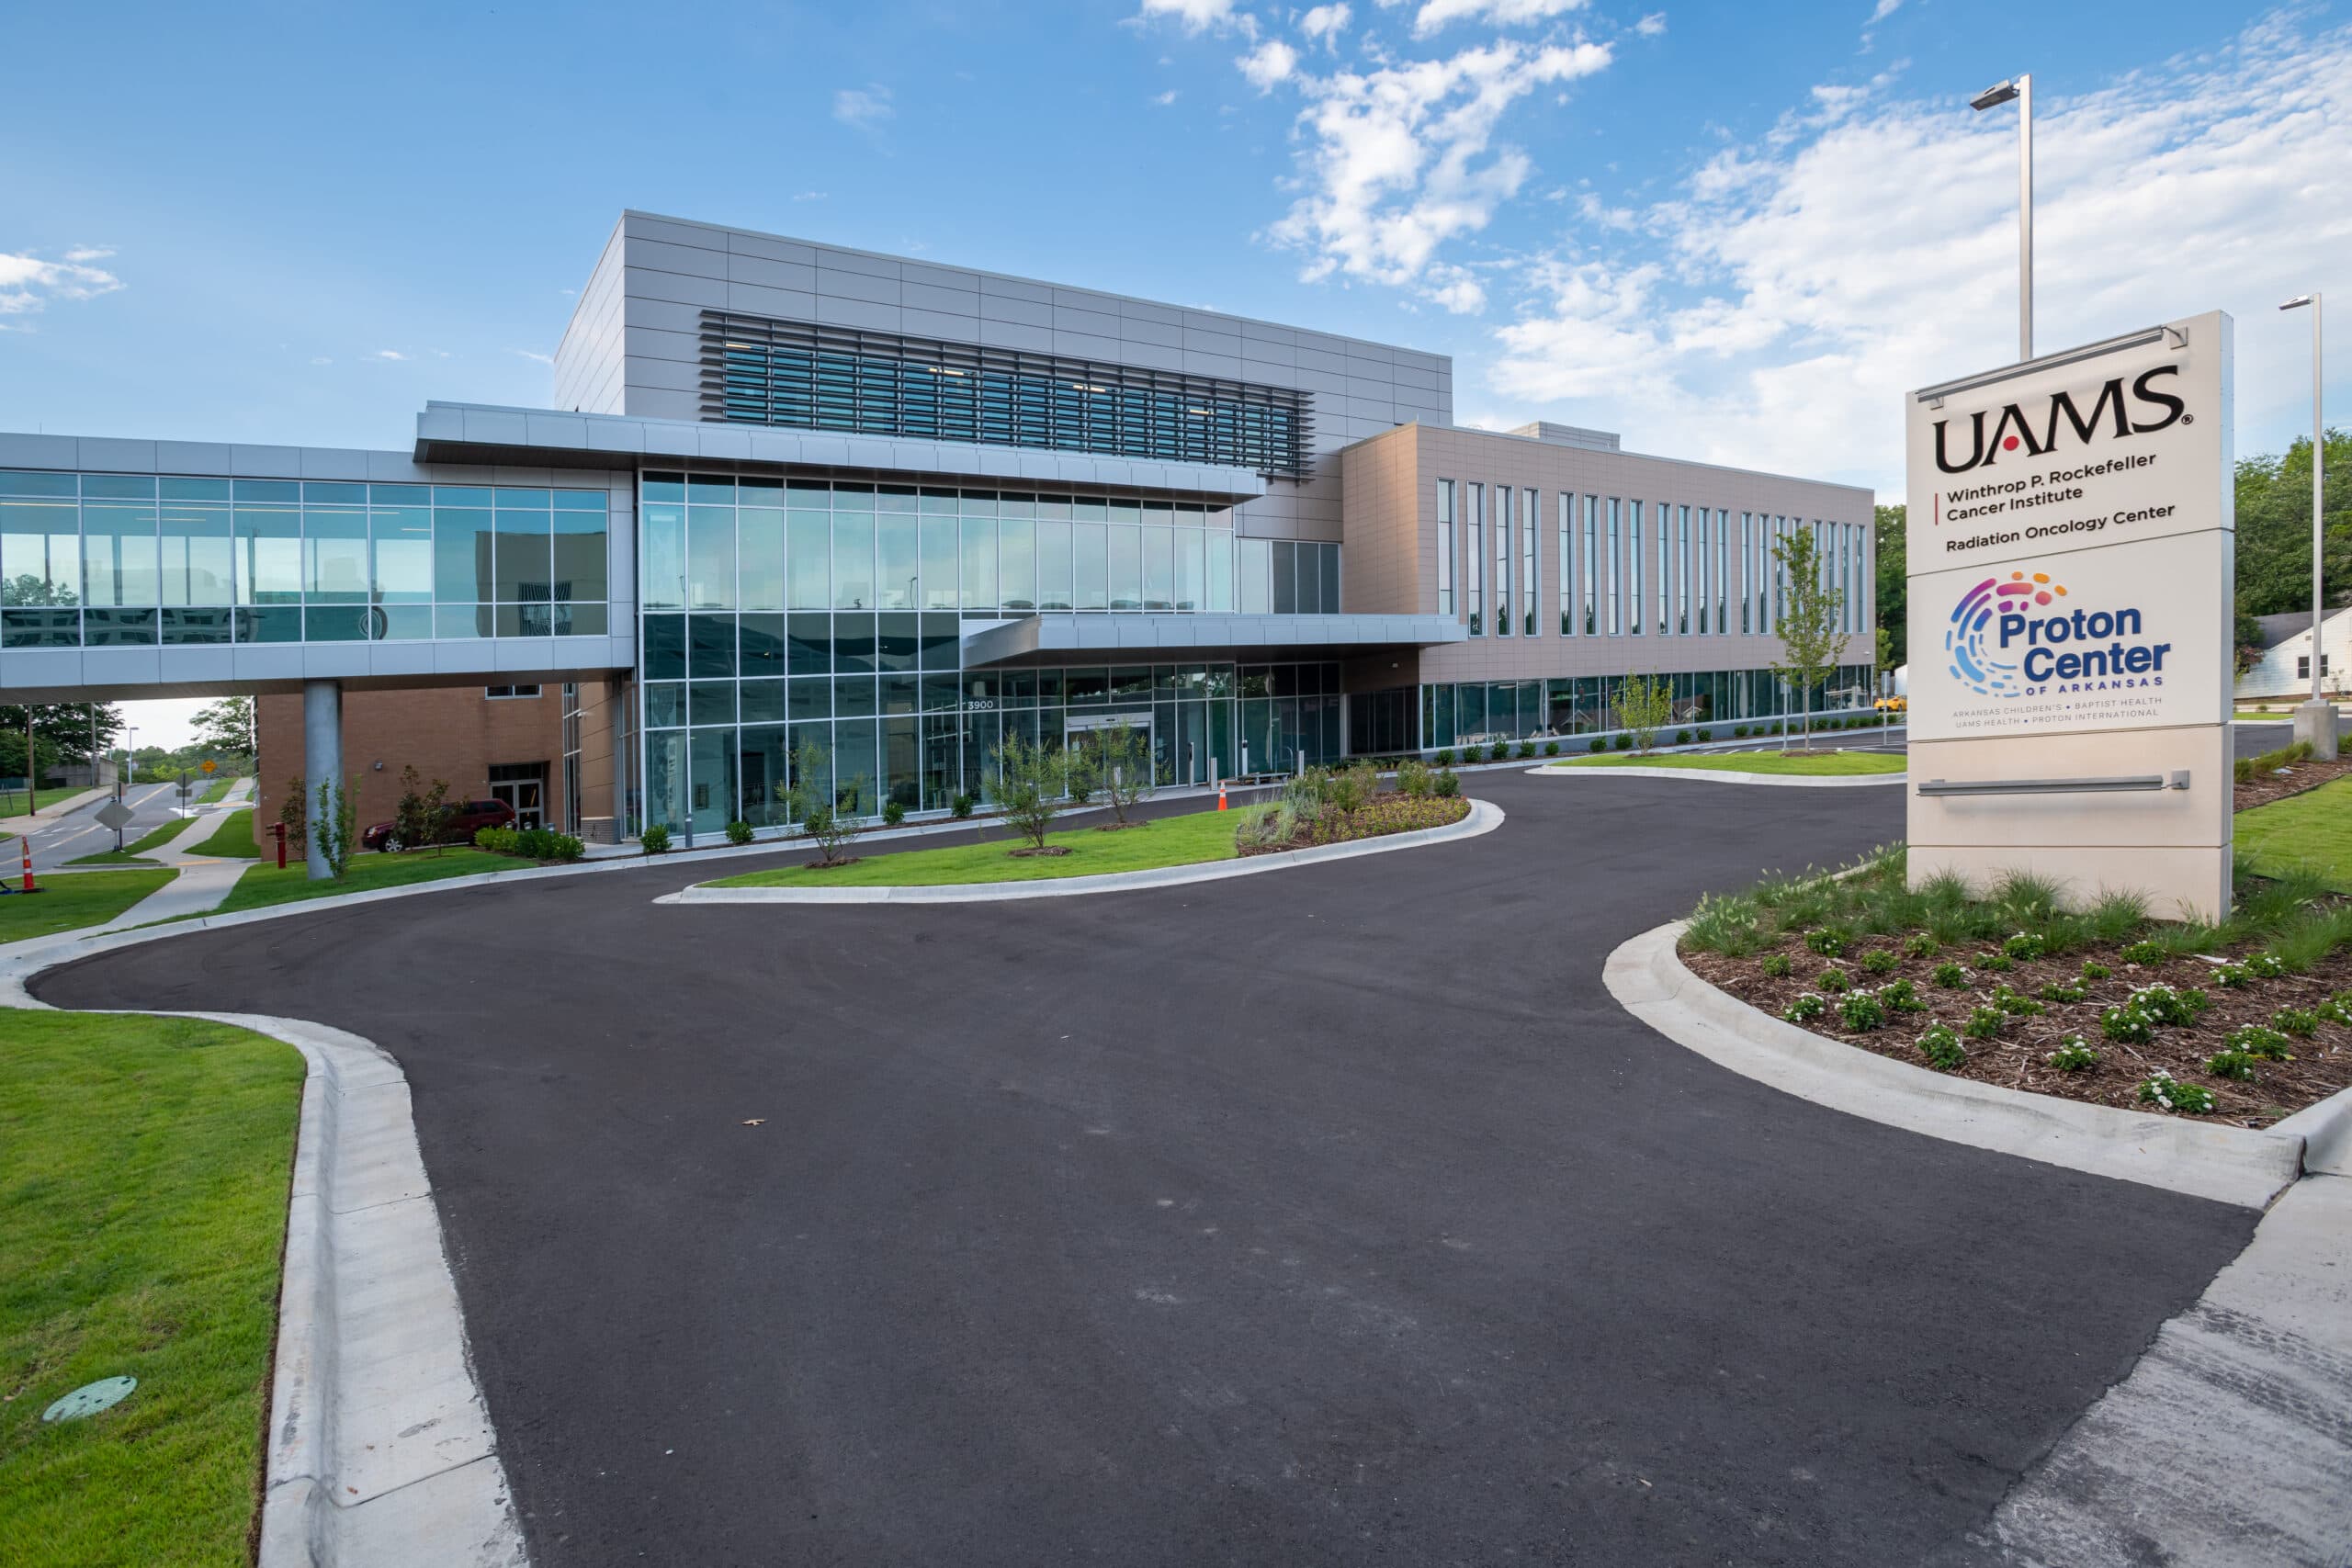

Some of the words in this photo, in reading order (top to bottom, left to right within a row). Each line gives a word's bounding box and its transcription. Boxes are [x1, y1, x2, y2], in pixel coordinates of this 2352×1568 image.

[1947, 480, 2026, 503] Winthrop
[2031, 476, 2044, 487] P.
[2050, 454, 2156, 484] Rockefeller
[1947, 502, 2006, 522] Cancer
[2010, 487, 2084, 509] Institute
[1947, 532, 2019, 552] Radiation
[2026, 515, 2108, 539] Oncology
[2113, 504, 2176, 525] Center
[2000, 608, 2141, 649] Proton
[2024, 643, 2170, 682] Center
[2026, 685, 2048, 696] OF
[2058, 676, 2163, 694] ARKANSAS
[968, 701, 993, 710] 3900
[1953, 708, 2001, 718] ARKANSAS
[2004, 704, 2063, 715] CHILDREN'S
[2075, 700, 2117, 709] BAPTIST
[2121, 697, 2162, 706] HEALTH
[1956, 719, 1981, 728] UAMS
[1984, 716, 2019, 726] HEALTH
[2032, 714, 2071, 723] PROTON
[2075, 709, 2158, 720] INTERNATIONAL
